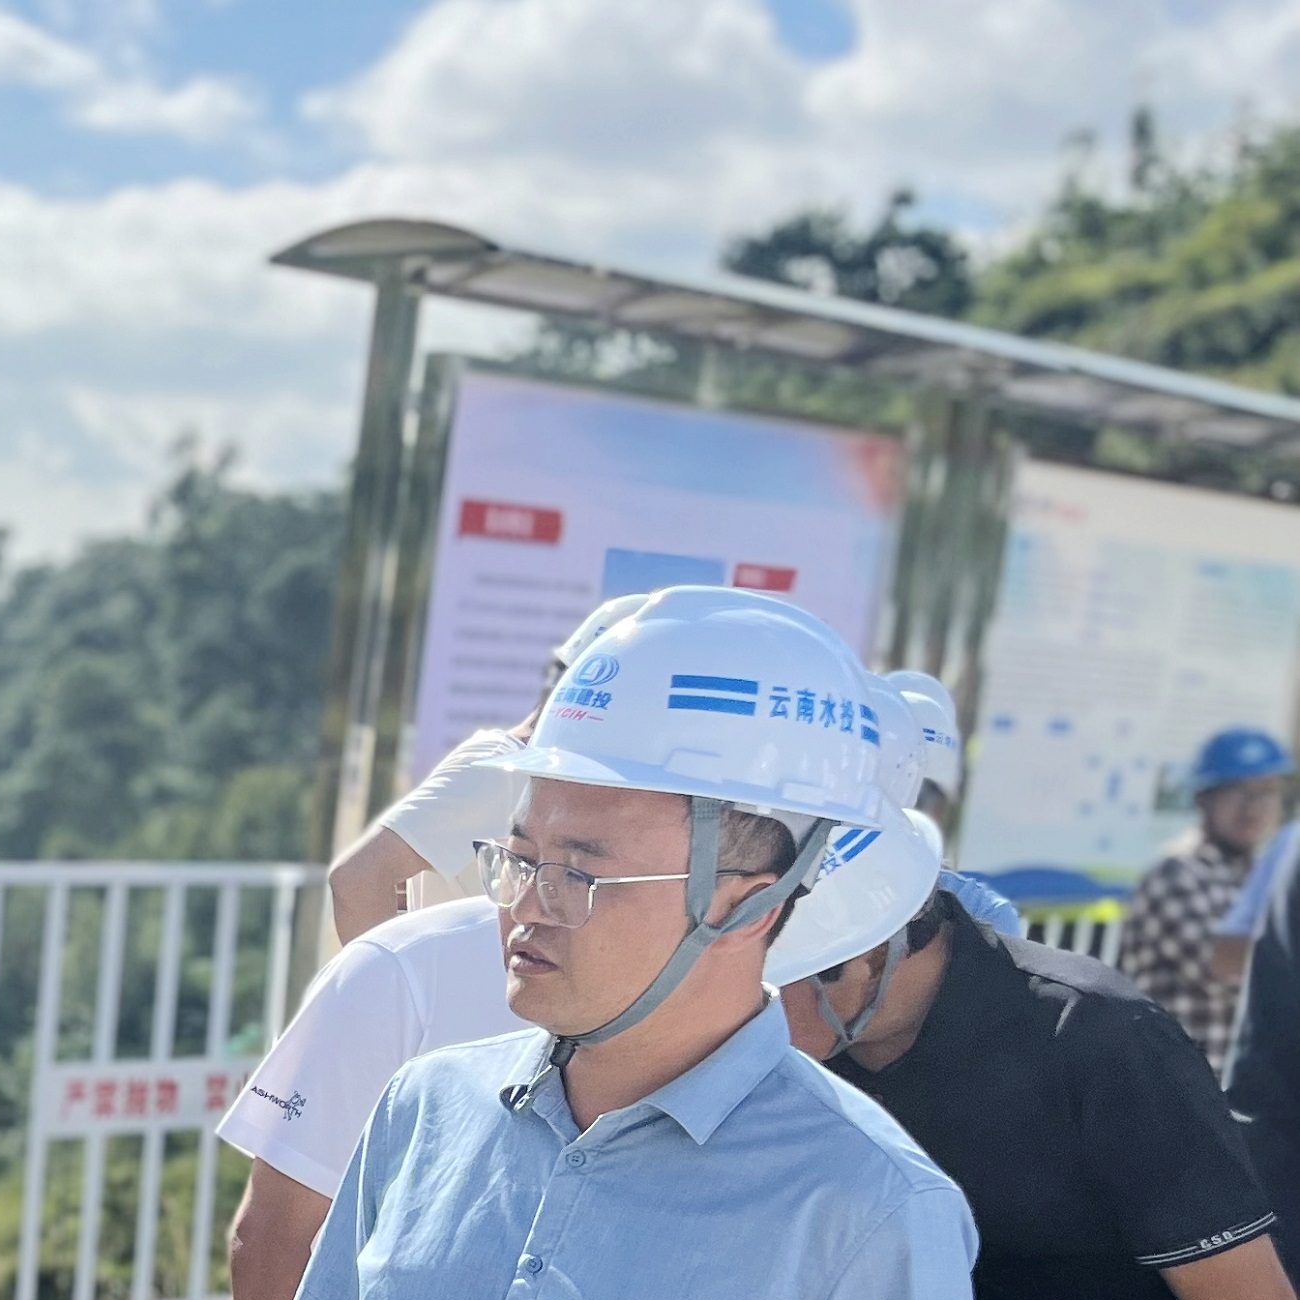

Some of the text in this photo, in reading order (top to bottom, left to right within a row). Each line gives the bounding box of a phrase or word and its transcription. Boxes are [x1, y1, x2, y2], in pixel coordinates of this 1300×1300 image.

[768, 686, 855, 734] 云南水投
[250, 1085, 303, 1118] ASHWORTH
